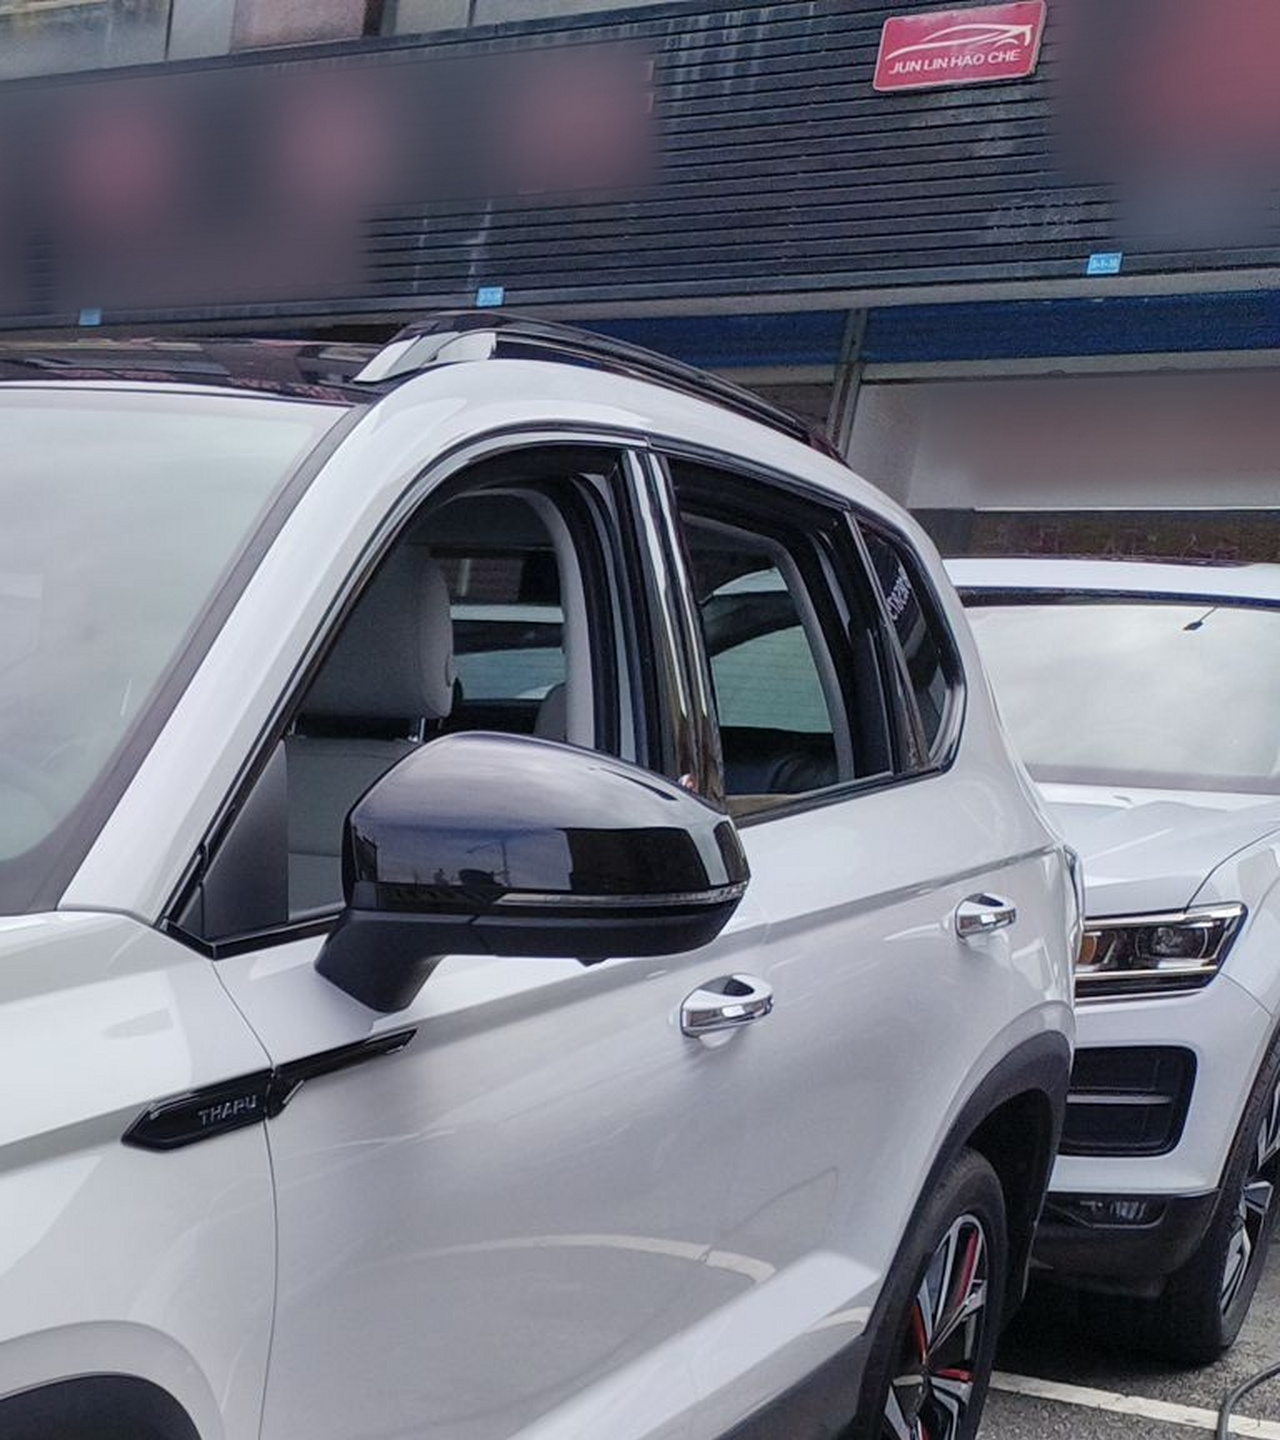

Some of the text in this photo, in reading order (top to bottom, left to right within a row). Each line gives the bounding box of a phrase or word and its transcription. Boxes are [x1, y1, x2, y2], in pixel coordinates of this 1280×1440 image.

[888, 49, 1021, 74] JUN LIN HAO CHE
